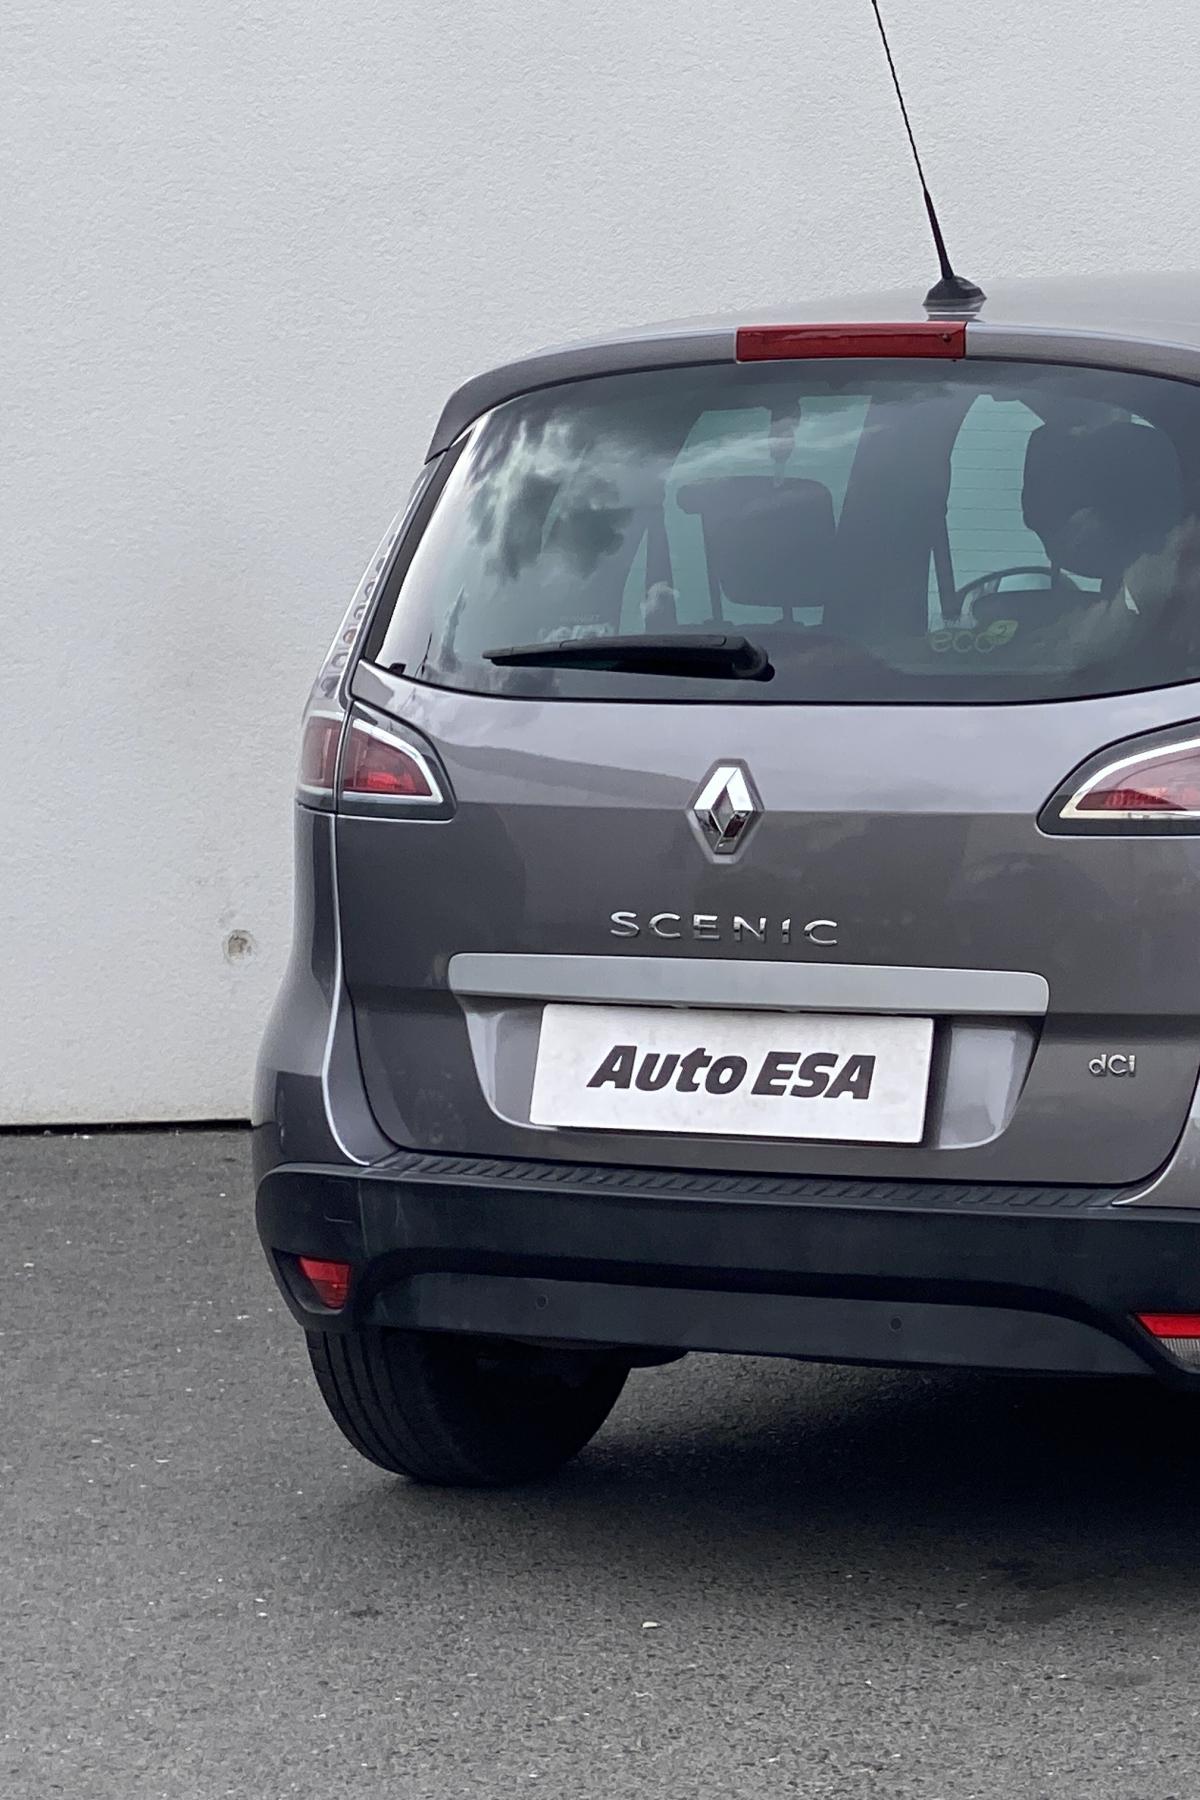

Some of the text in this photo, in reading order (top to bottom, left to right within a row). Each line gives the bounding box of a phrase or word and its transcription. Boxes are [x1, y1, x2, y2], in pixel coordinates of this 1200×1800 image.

[609, 911, 838, 945] SCENIC
[586, 1045, 876, 1100] Auto ESA
